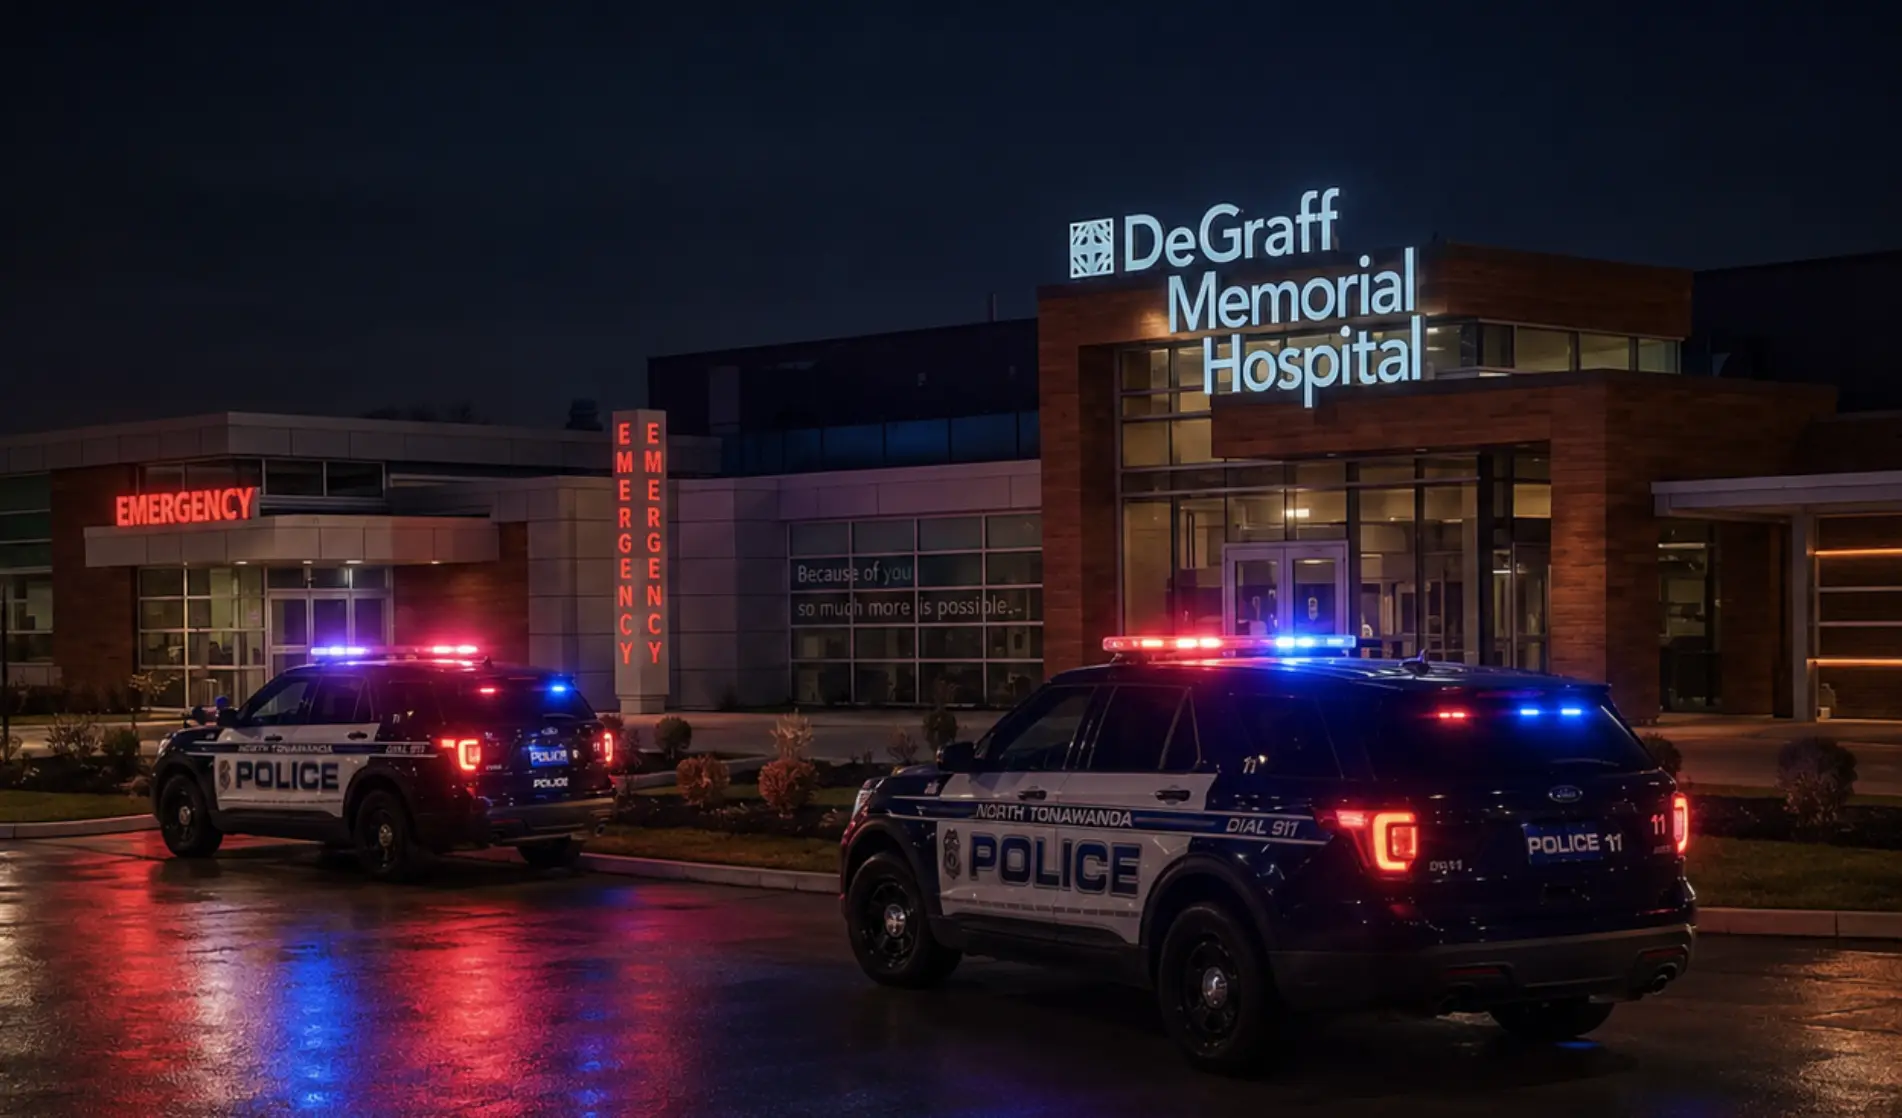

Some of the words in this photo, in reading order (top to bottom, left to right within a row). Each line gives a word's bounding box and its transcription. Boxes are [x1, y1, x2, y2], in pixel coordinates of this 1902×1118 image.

[1124, 187, 1340, 272] DeGraff
[1168, 247, 1415, 333] Memorial
[1203, 315, 1422, 409] Hospital
[115, 487, 253, 526] EMERGENCY
[616, 422, 633, 664] EMERGENCY
[644, 422, 662, 664] EMERGENCY
[798, 564, 859, 583] Because
[864, 560, 881, 582] of
[883, 565, 912, 586] you
[798, 602, 815, 617] so
[820, 597, 863, 617] much
[868, 601, 911, 616] more
[919, 596, 932, 616] is
[236, 761, 340, 791] POLICE
[976, 803, 1025, 820] NORTH
[1029, 806, 1134, 828] TONAWANDA
[1225, 816, 1267, 836] DIAL
[1270, 819, 1300, 836] 911
[1650, 814, 1667, 835] 11
[1527, 833, 1600, 855] POLICE
[1604, 832, 1623, 853] 11
[970, 832, 1141, 897] POLICE
